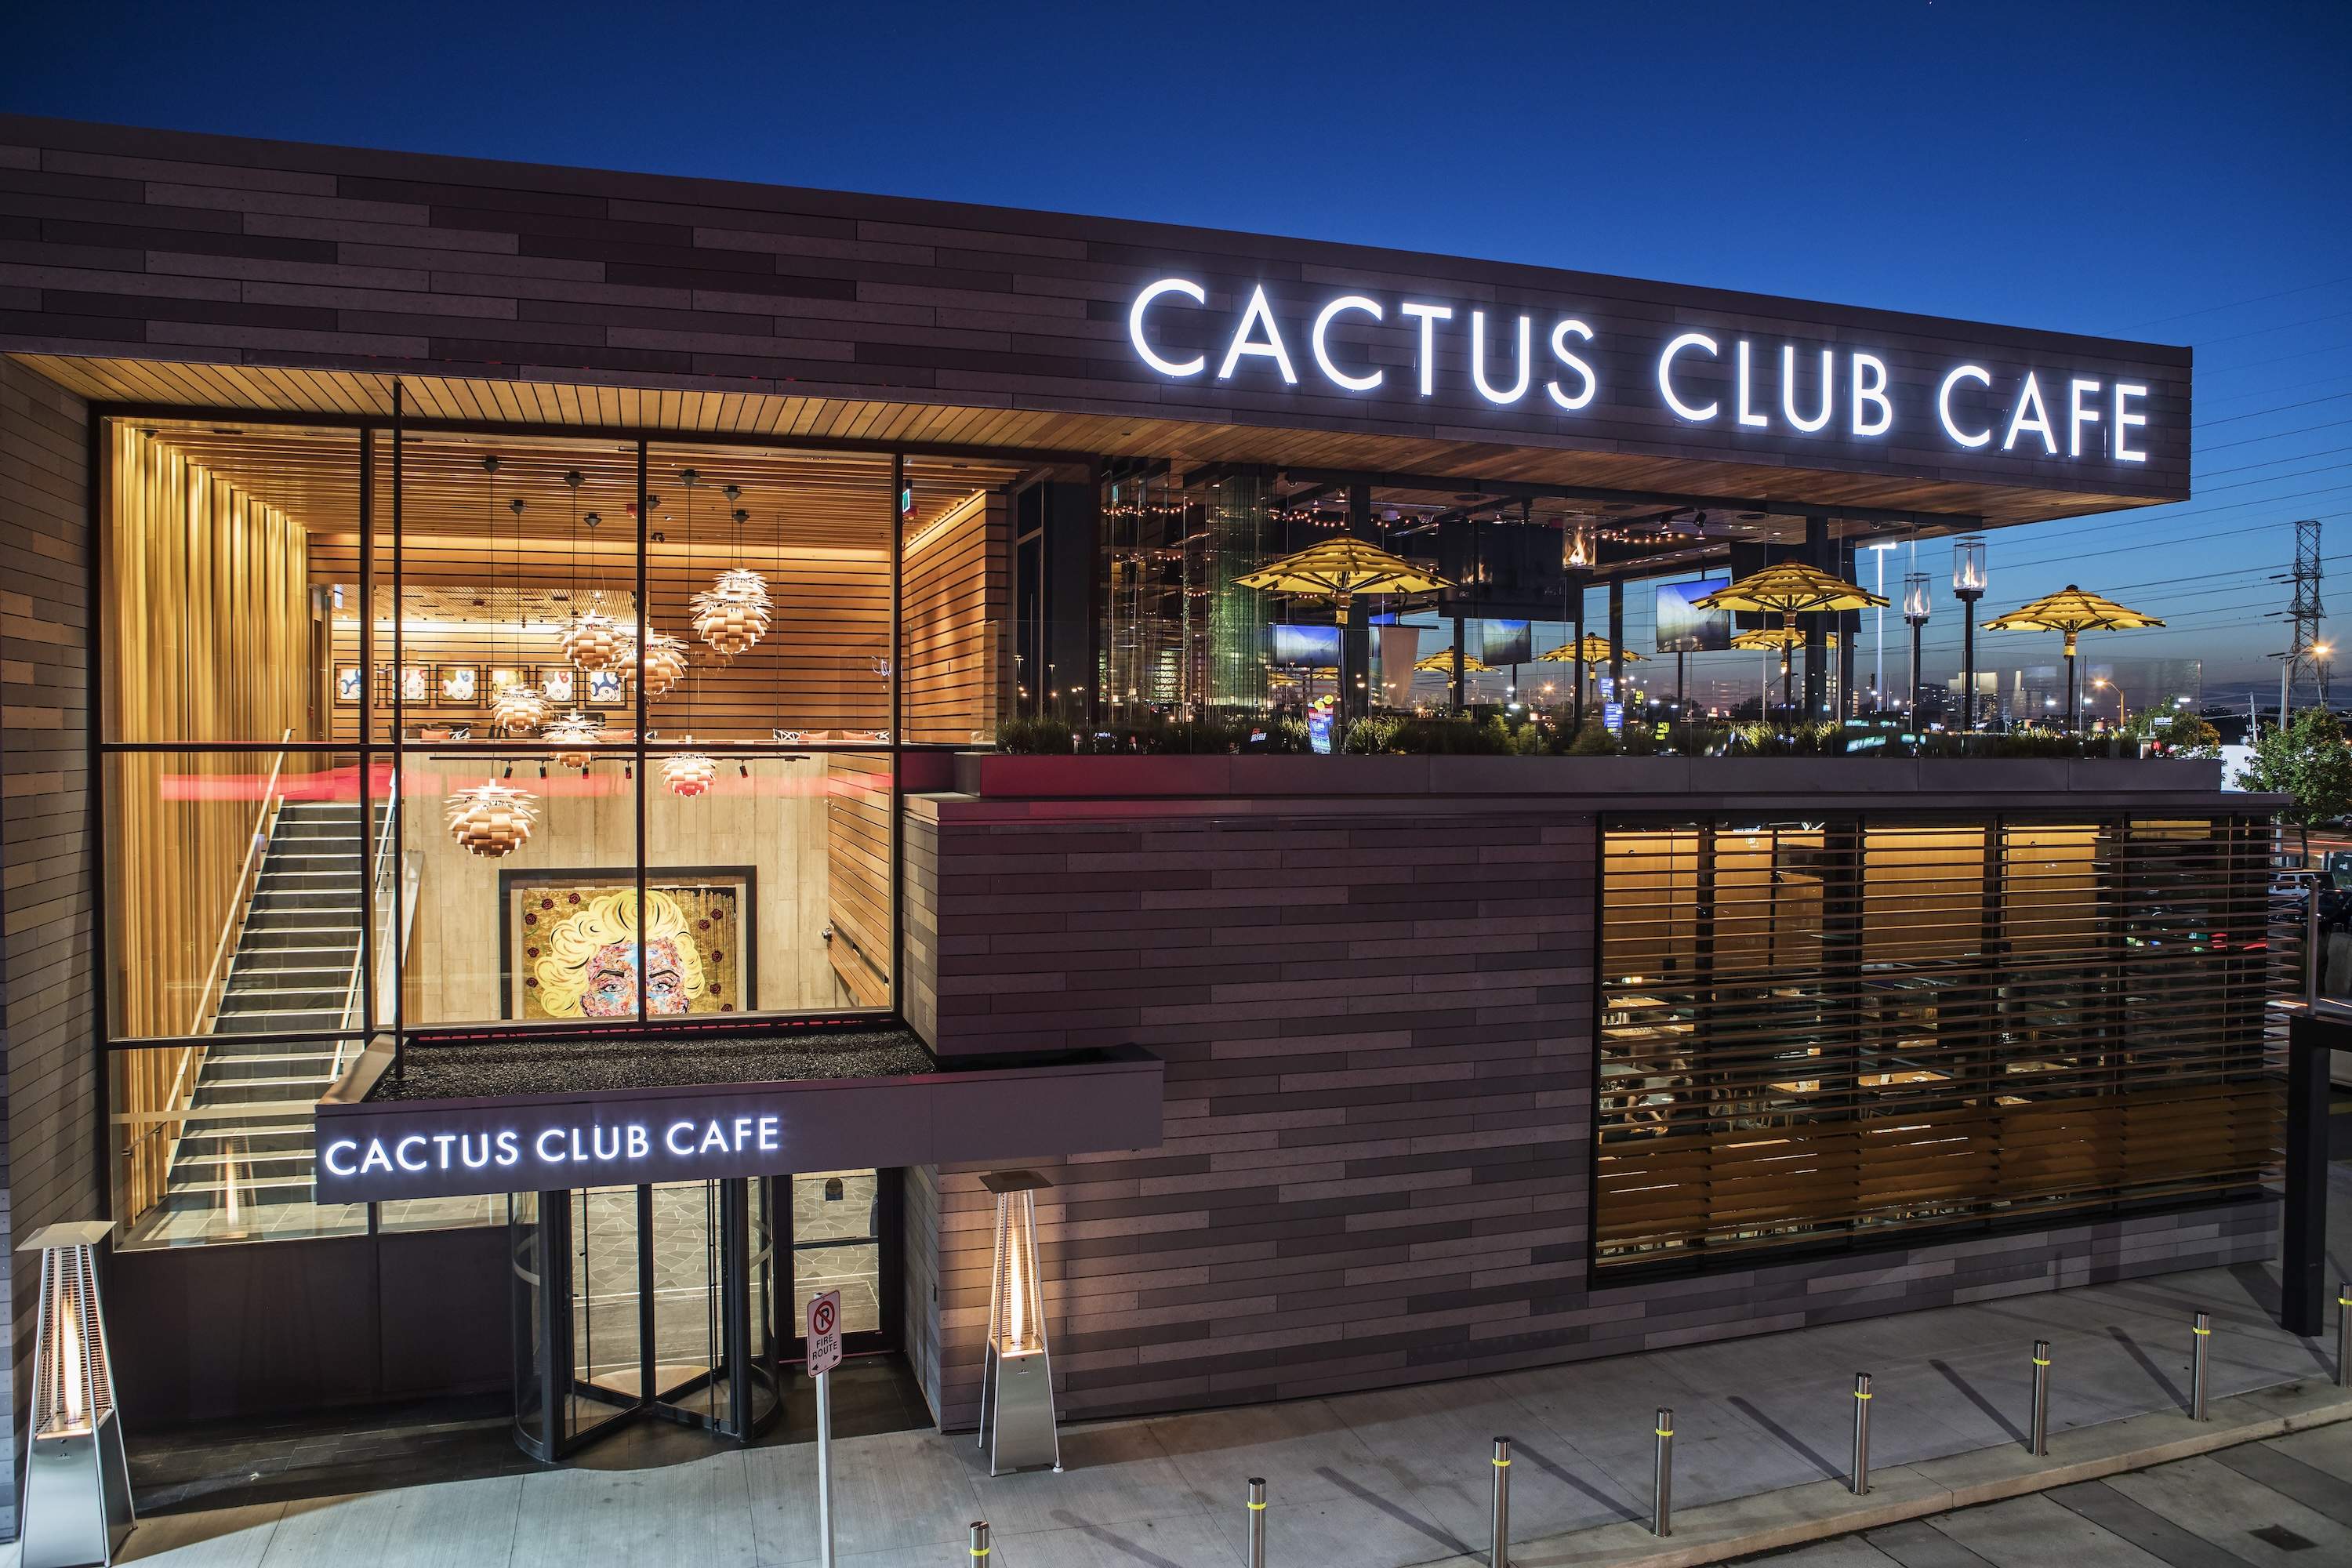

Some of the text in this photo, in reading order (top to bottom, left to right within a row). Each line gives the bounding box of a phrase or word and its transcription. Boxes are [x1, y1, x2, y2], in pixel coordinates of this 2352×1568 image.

[1129, 278, 2147, 461] CACTUS CLUB CAFE
[325, 1117, 778, 1176] CACTUS CLUB CAFE
[812, 1341, 838, 1360] ROUTE
[816, 1333, 833, 1348] FIRE
